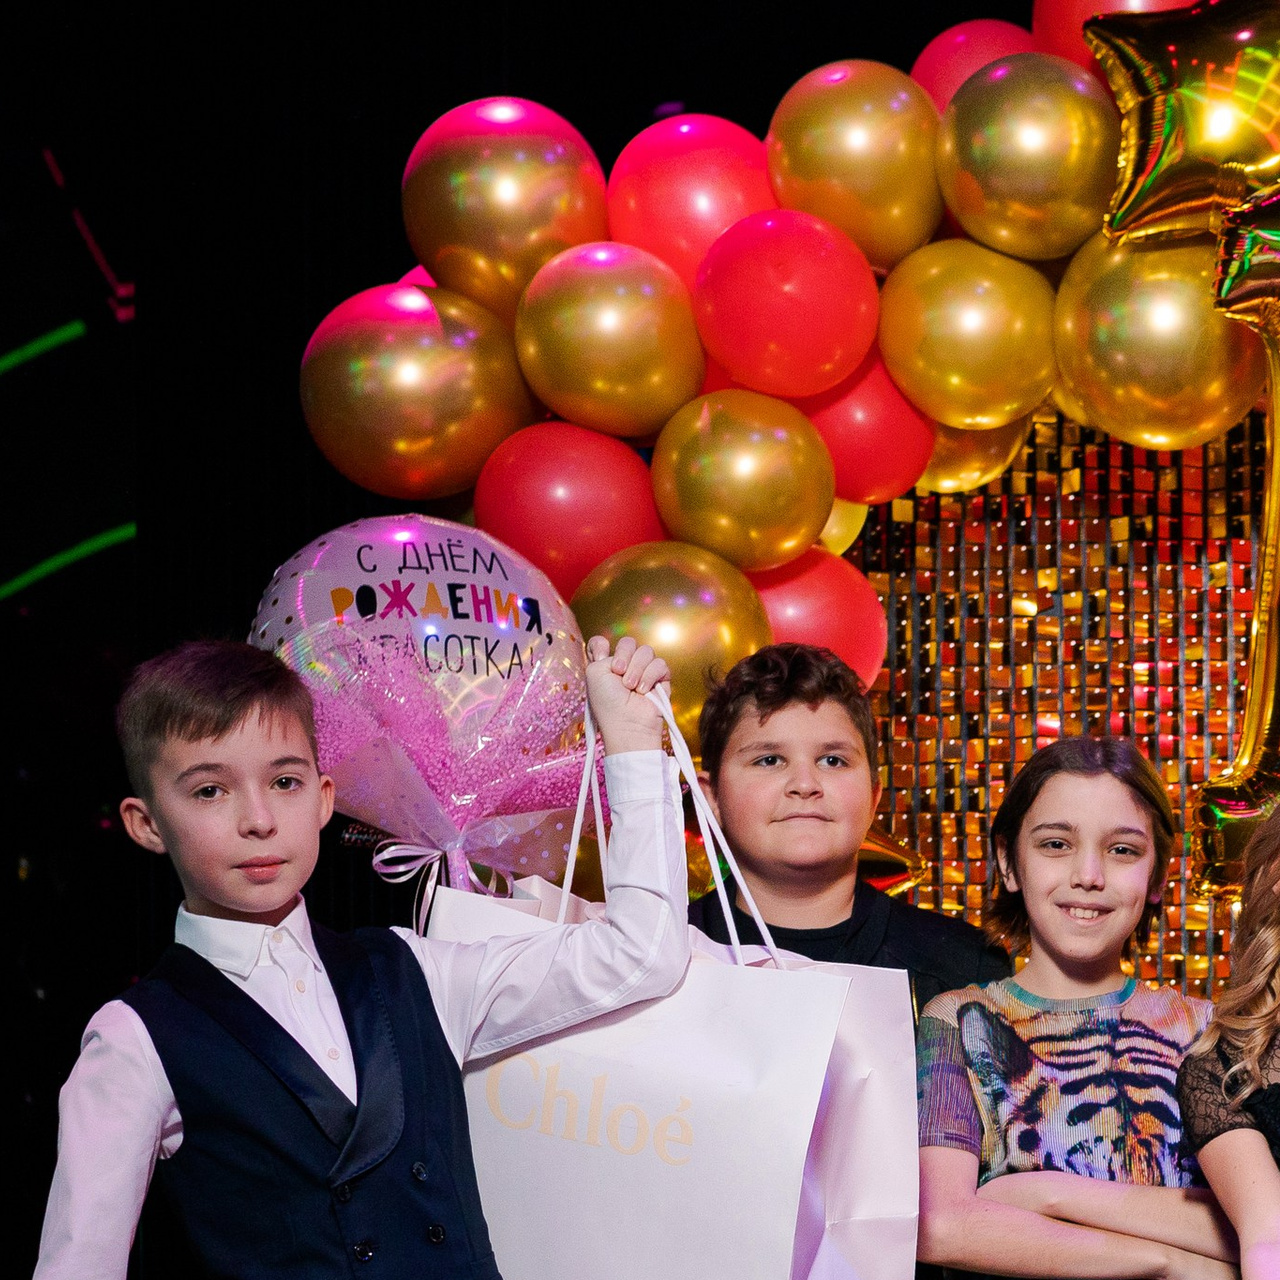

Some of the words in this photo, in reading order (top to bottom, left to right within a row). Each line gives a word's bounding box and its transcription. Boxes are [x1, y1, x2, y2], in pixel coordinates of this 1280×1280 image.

[356, 543, 378, 574] С
[398, 539, 509, 581] ДНЁМ
[485, 1052, 695, 1167] Chloé
